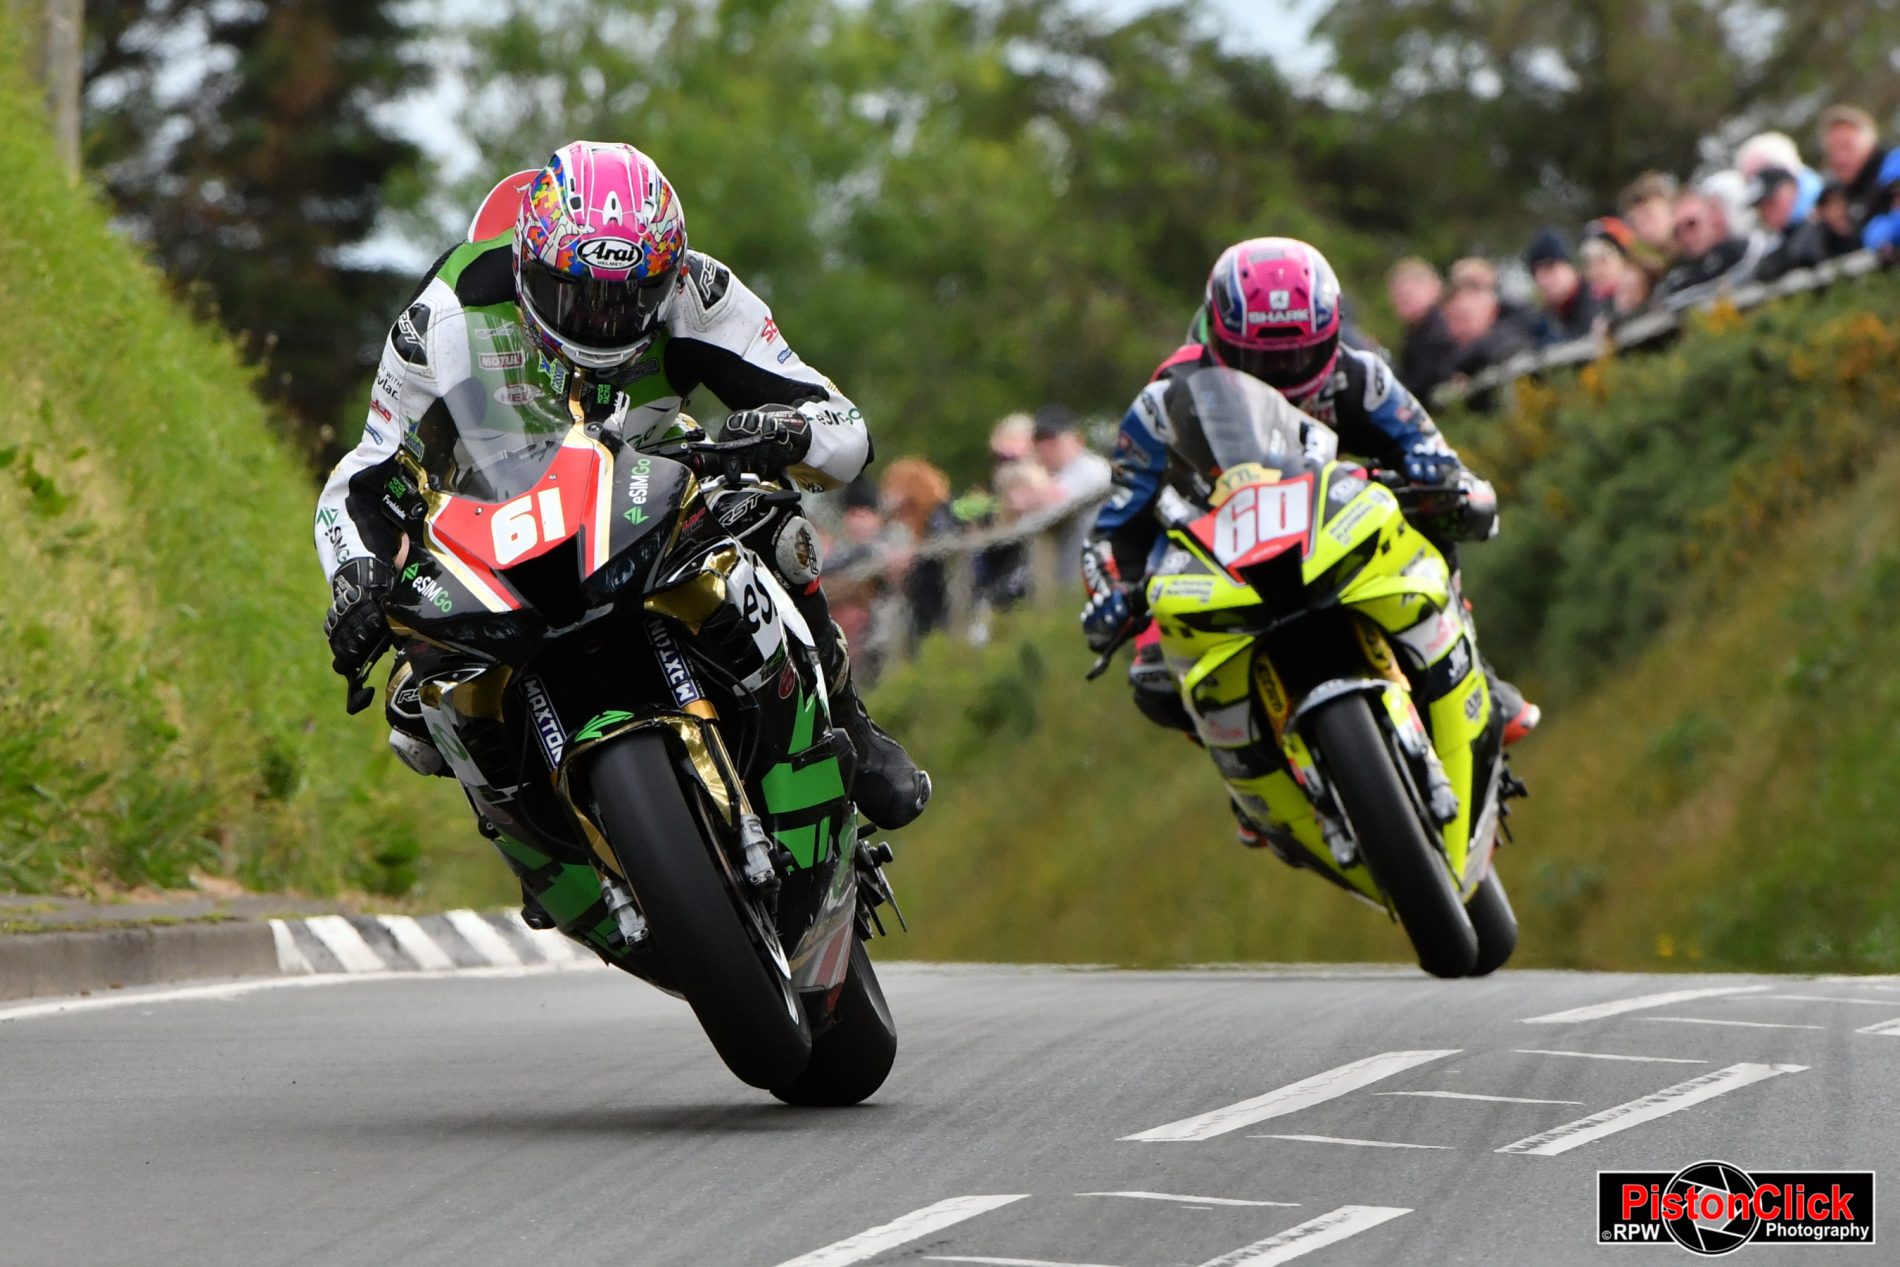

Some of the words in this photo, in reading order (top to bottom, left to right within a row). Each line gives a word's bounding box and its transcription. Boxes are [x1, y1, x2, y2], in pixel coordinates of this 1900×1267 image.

[581, 241, 637, 262] Arai
[1248, 309, 1310, 325] SHARK
[628, 458, 651, 505] eSIMGo
[490, 486, 567, 566] 61
[719, 493, 762, 526] RST
[1213, 479, 1309, 567] 60
[411, 574, 453, 614] eSIMGo
[524, 678, 563, 763] MAXTON
